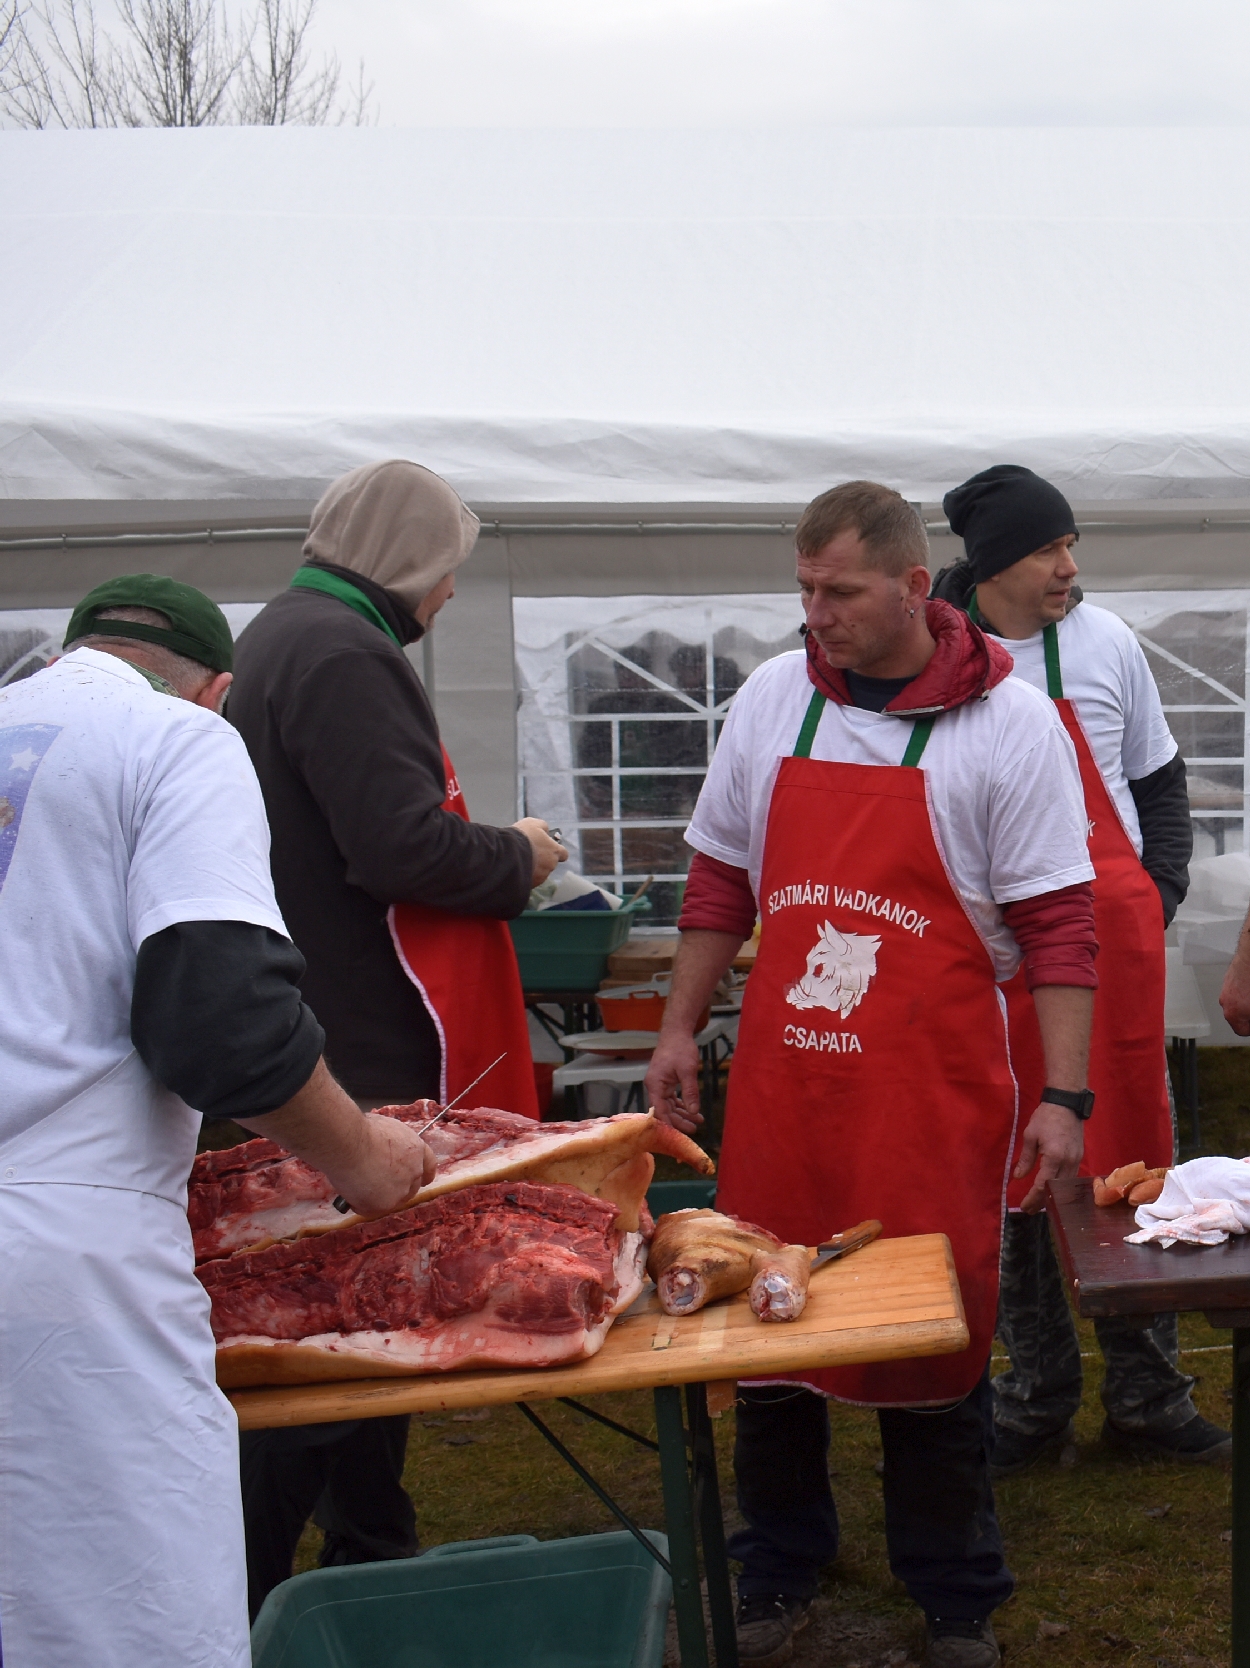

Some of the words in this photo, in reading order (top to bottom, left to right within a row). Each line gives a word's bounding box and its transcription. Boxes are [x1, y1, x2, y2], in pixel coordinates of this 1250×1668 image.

[768, 879, 829, 915] SZATMÁRI
[834, 886, 931, 938] VADKANOK
[783, 1024, 863, 1054] CSAPATA
